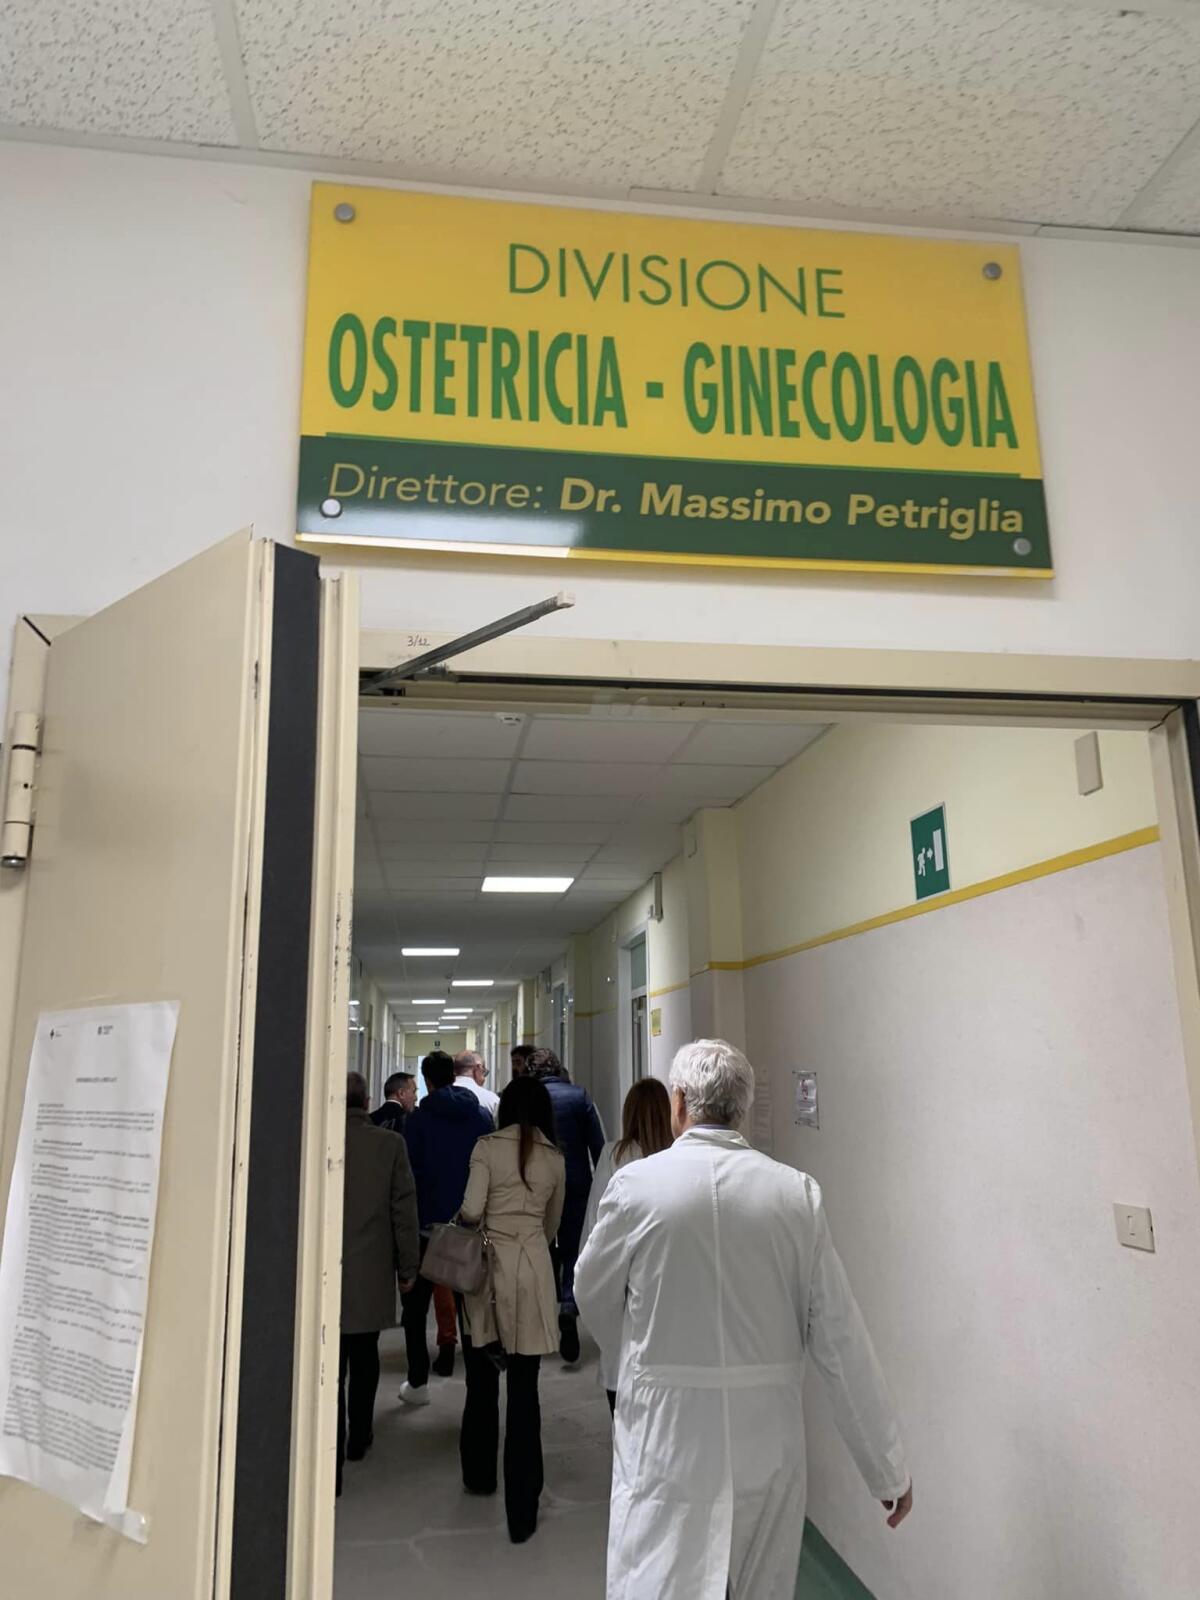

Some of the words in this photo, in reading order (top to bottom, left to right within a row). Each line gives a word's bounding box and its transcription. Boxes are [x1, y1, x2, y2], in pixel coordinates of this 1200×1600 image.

[509, 243, 845, 318] DIVISIONE
[328, 313, 627, 428] OSTETRICIA
[646, 382, 664, 399] -
[684, 341, 1018, 448] GINECOLOGIA
[329, 463, 542, 508] Direttore:
[561, 478, 621, 513] Dr.
[640, 482, 832, 524] Massimo
[848, 493, 1022, 540] Petriglia
